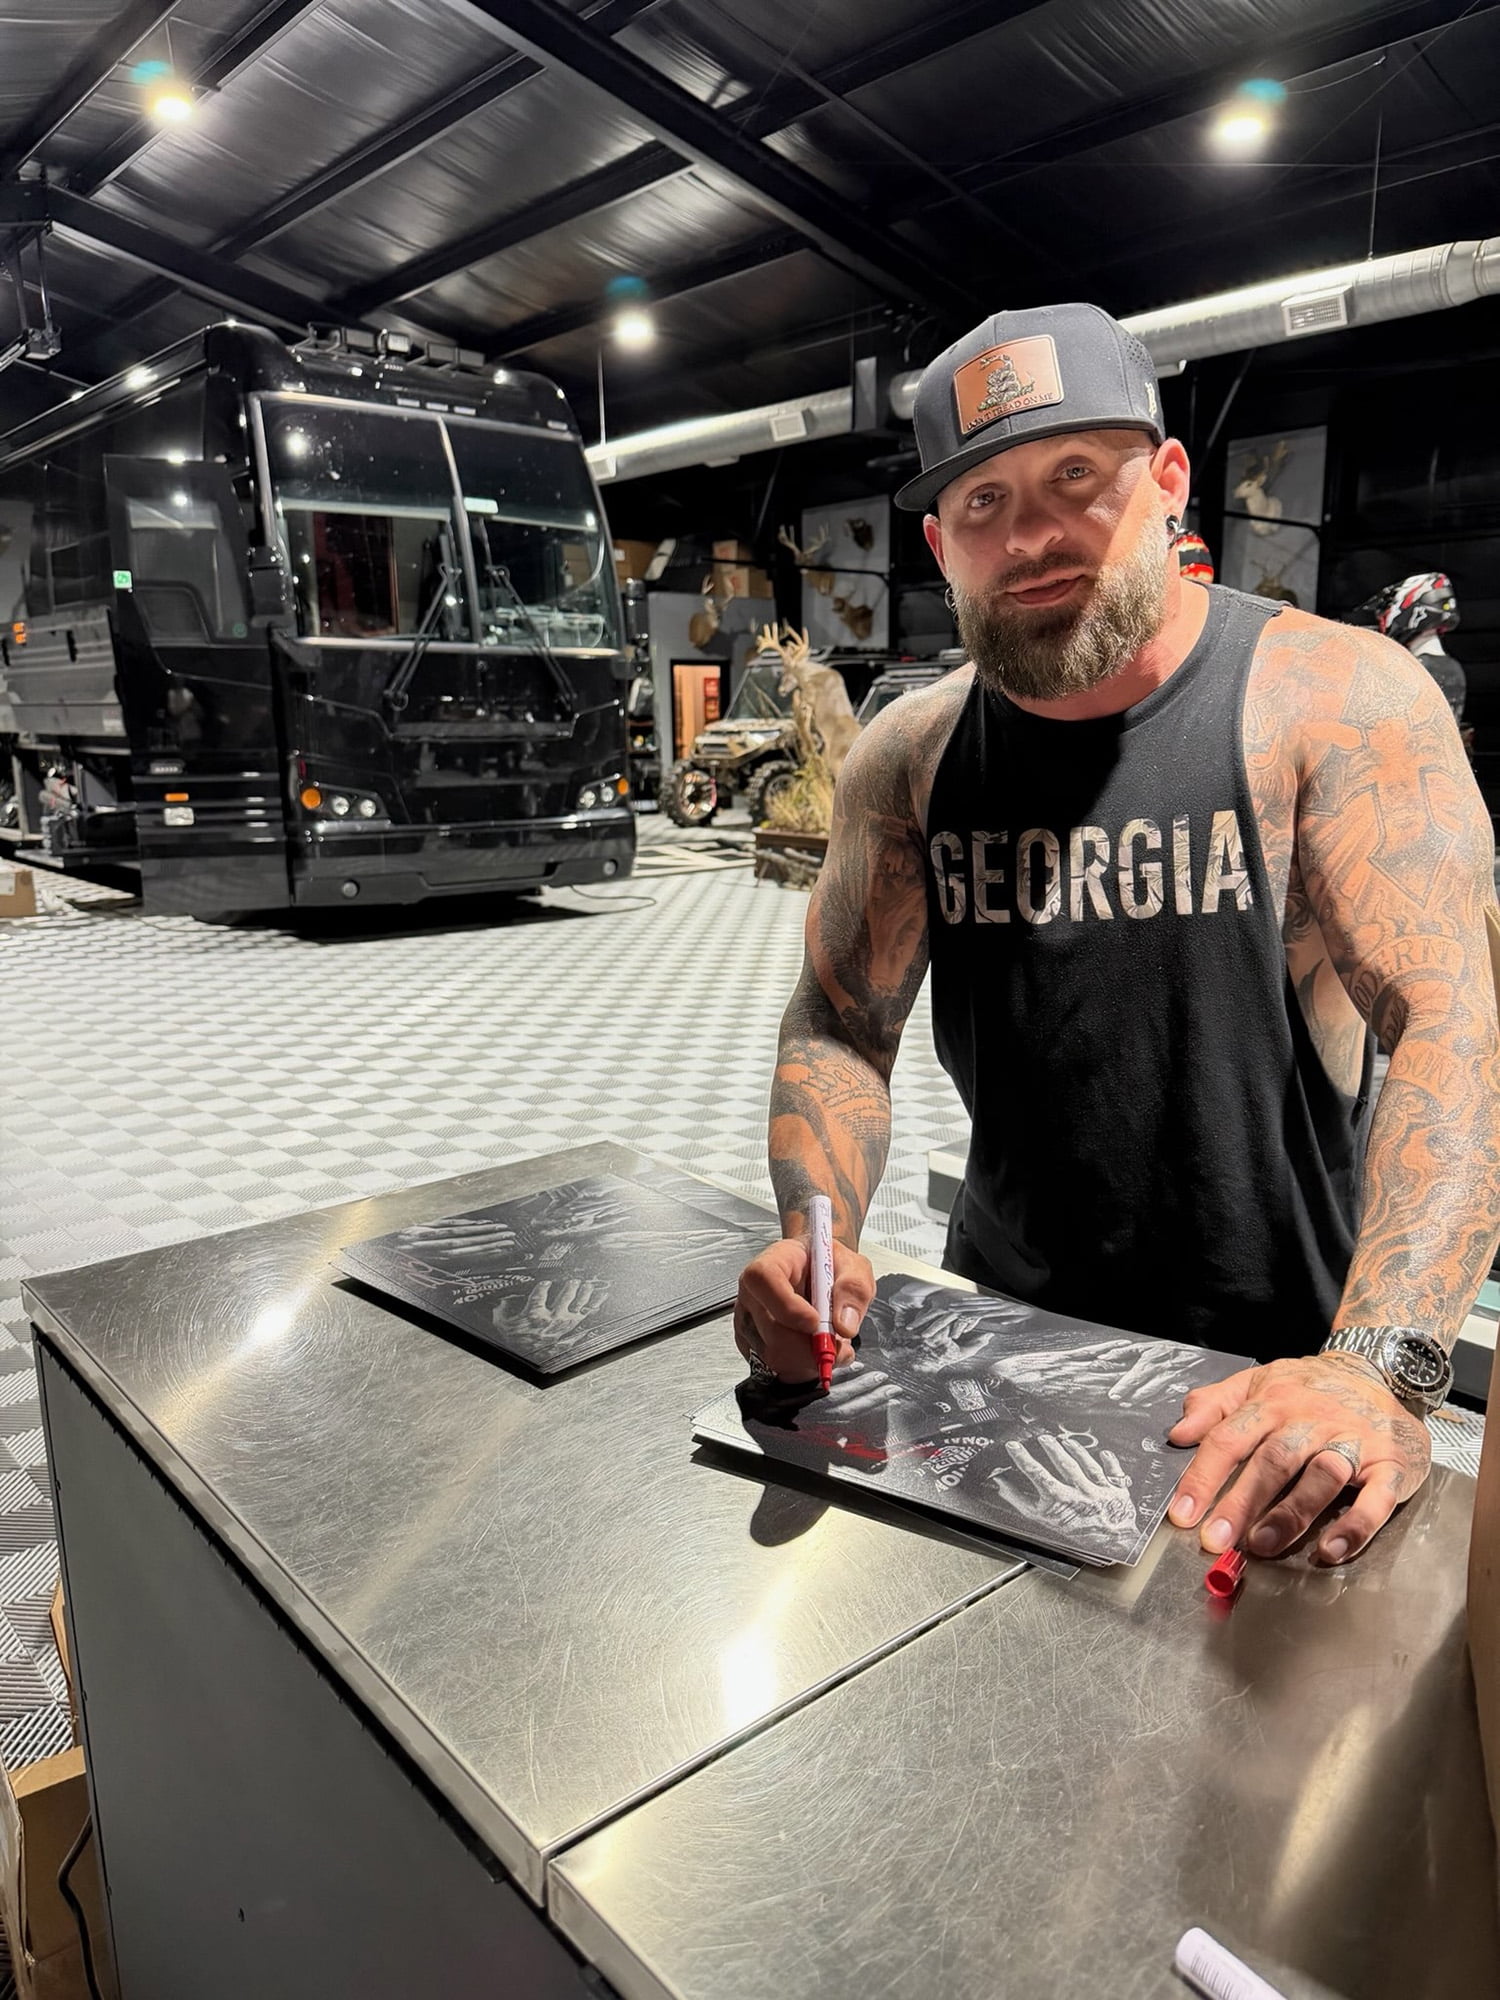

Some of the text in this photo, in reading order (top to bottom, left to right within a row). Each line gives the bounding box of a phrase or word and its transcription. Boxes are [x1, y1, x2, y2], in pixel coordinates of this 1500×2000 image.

[993, 399, 1022, 417] TREAD
[1023, 396, 1038, 407] ON
[1039, 392, 1054, 402] ME
[930, 810, 1255, 925] GEORGIA
